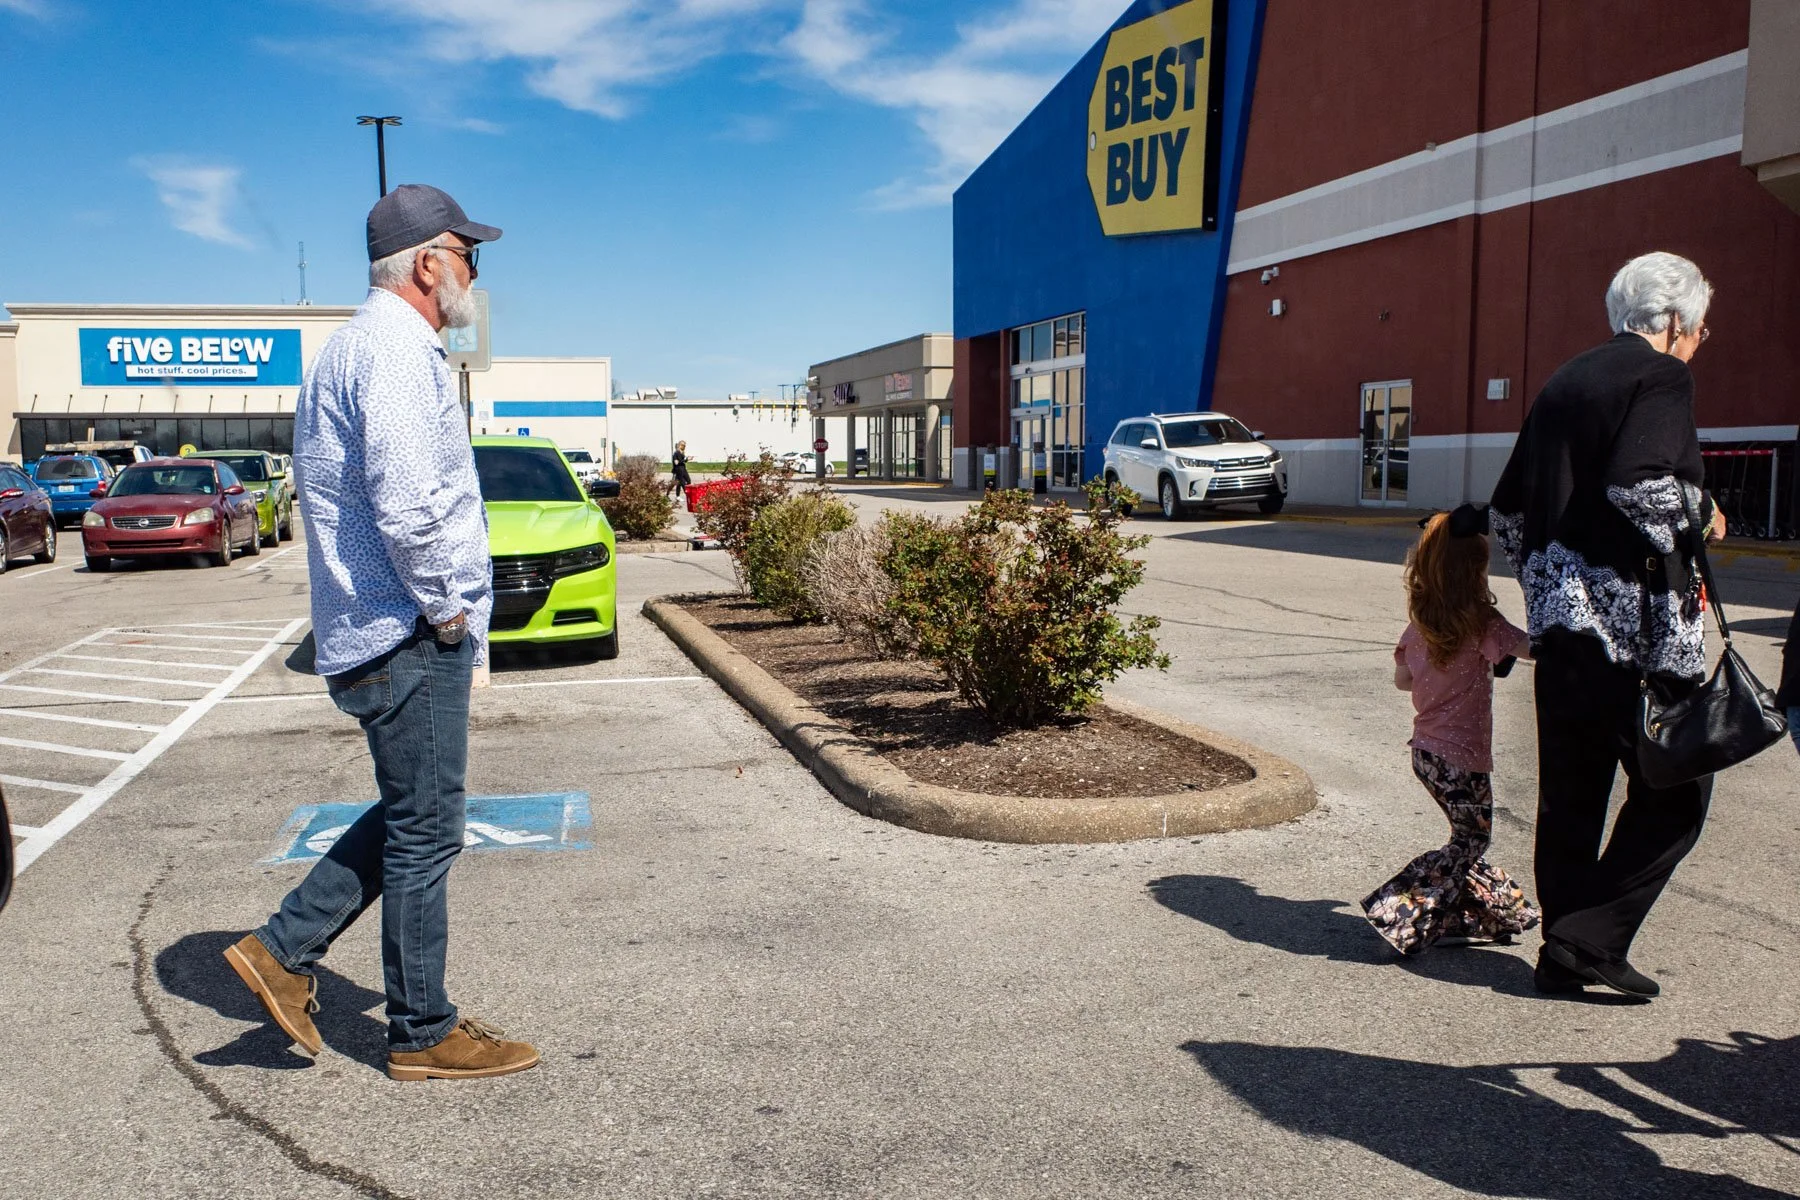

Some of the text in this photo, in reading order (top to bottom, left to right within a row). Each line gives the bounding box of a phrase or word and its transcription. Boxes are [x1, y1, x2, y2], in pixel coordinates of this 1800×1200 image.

[1105, 37, 1204, 132] BEST
[1106, 127, 1190, 206] BUY
[107, 336, 274, 363] five BELOW
[137, 366, 247, 376] hot stuff. cool prices.
